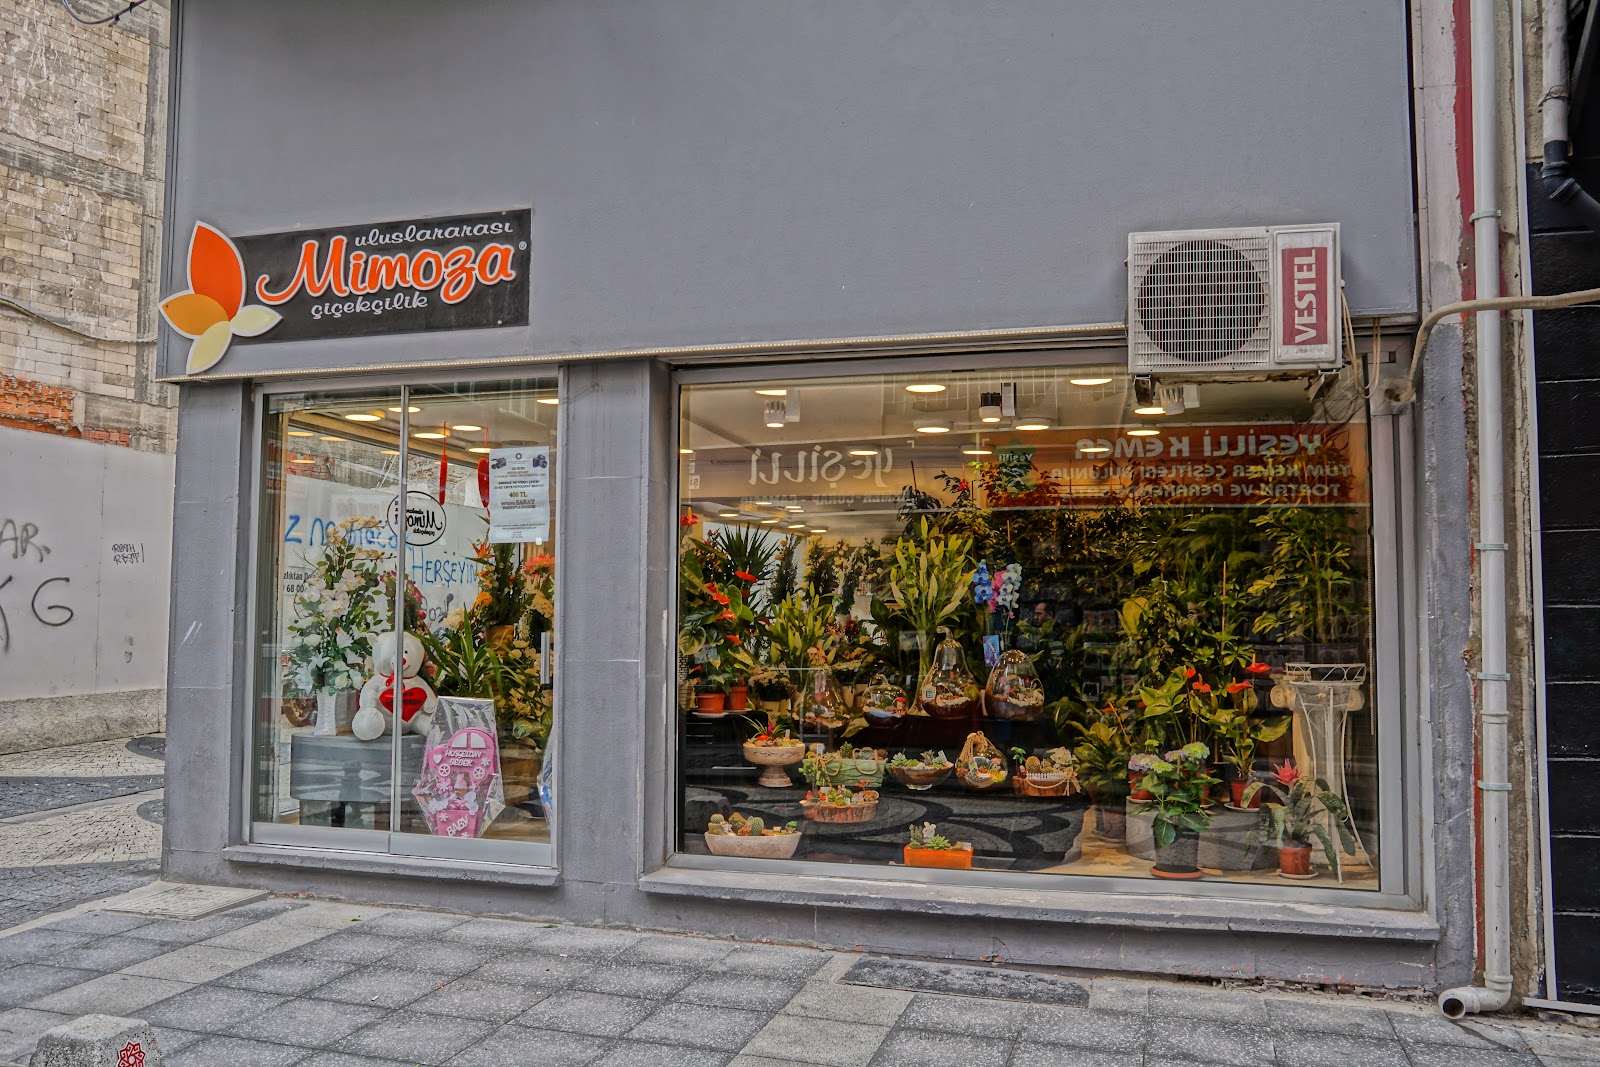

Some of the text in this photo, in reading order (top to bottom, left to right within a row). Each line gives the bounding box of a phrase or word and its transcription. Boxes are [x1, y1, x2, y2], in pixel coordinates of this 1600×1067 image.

[355, 222, 513, 247] uluslararası
[255, 235, 516, 305] Mimoza
[311, 291, 428, 320] çiçekçilik
[1293, 249, 1317, 343] VESTEL
[446, 814, 469, 837] BABY
